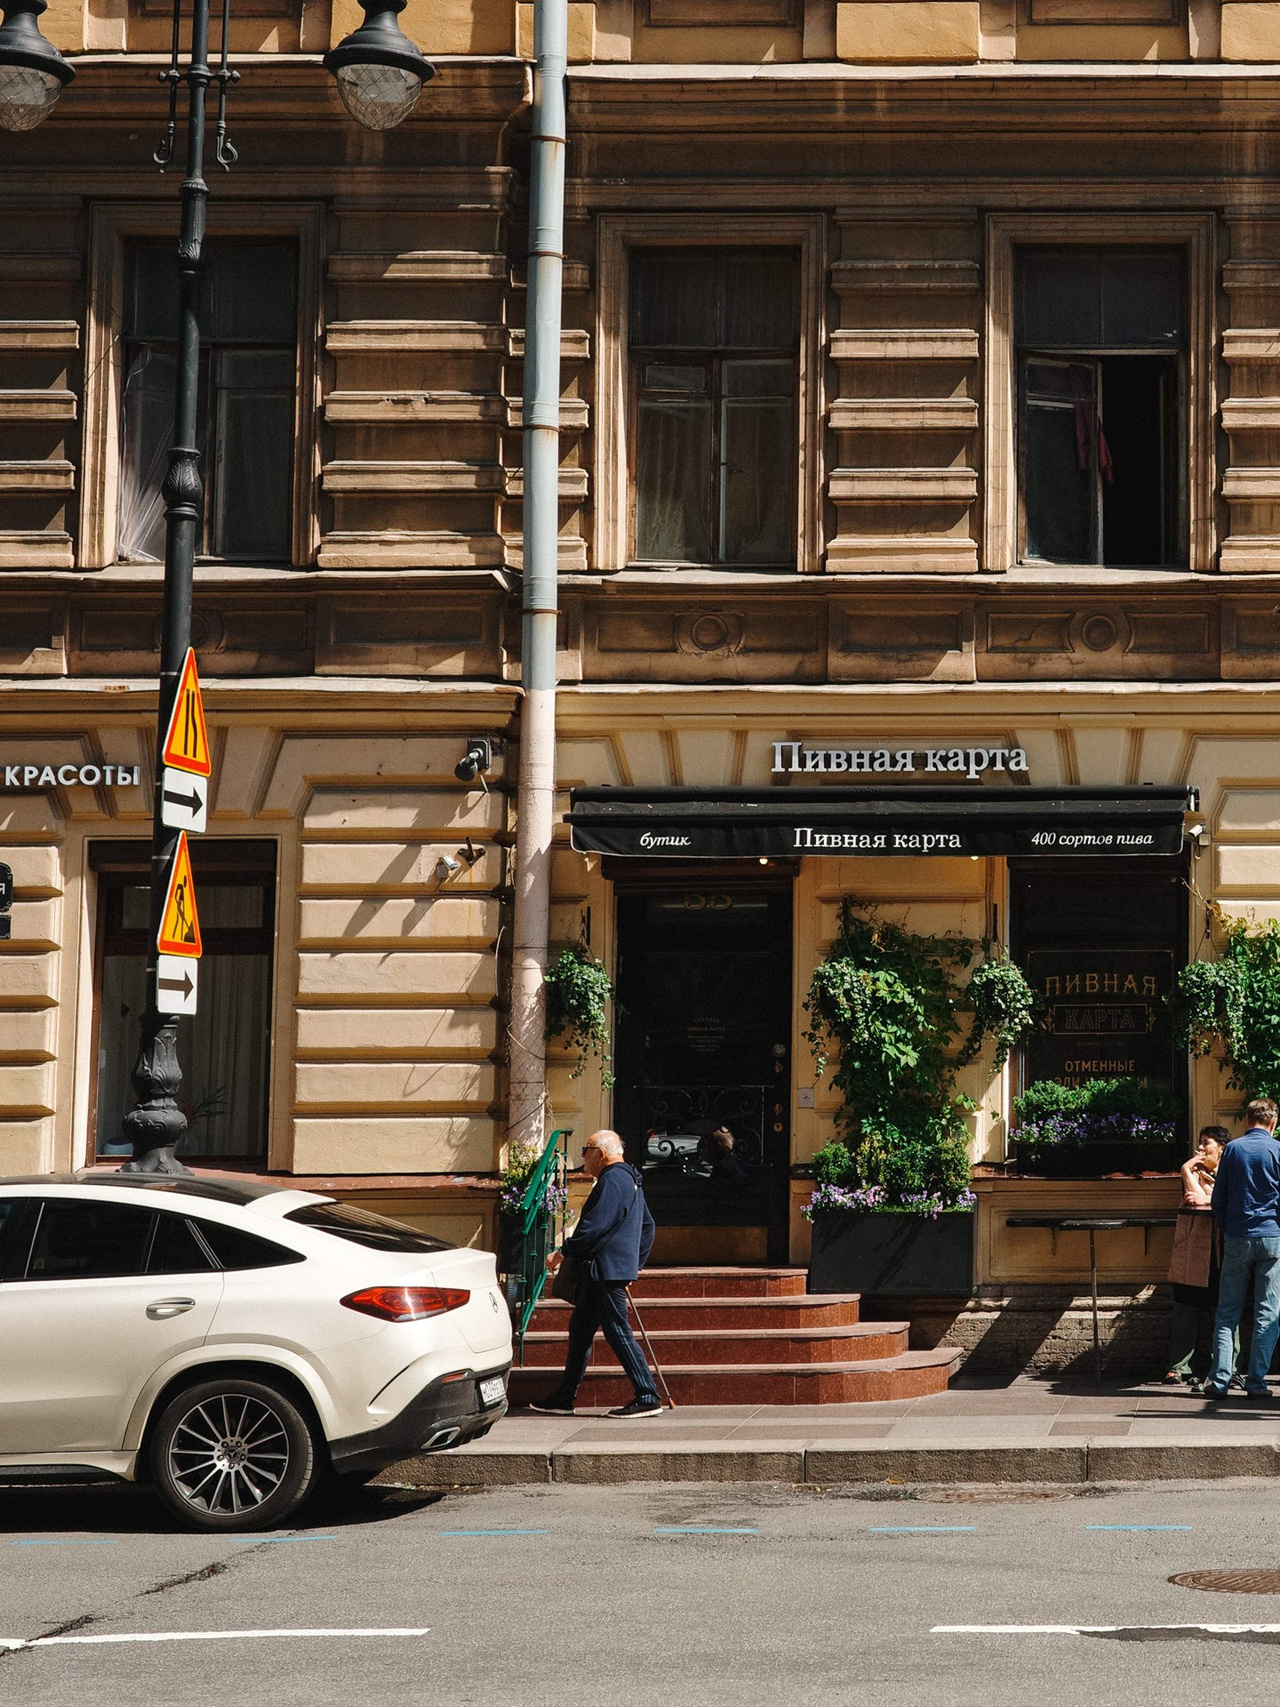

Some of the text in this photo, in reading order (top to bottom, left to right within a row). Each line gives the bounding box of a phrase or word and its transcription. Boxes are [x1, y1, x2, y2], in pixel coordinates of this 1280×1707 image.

[771, 742, 1030, 779] Пивная карта
[5, 764, 140, 786] КРАСОТЫ
[640, 831, 692, 850] бутик
[793, 827, 962, 853] Пивная карта
[1031, 831, 1155, 848] 400 сортов пива
[1045, 973, 1156, 997] ПИВНАЯ
[1065, 1009, 1135, 1030] КАРТА
[1065, 1060, 1135, 1072] ОТМЕННЫЕ
